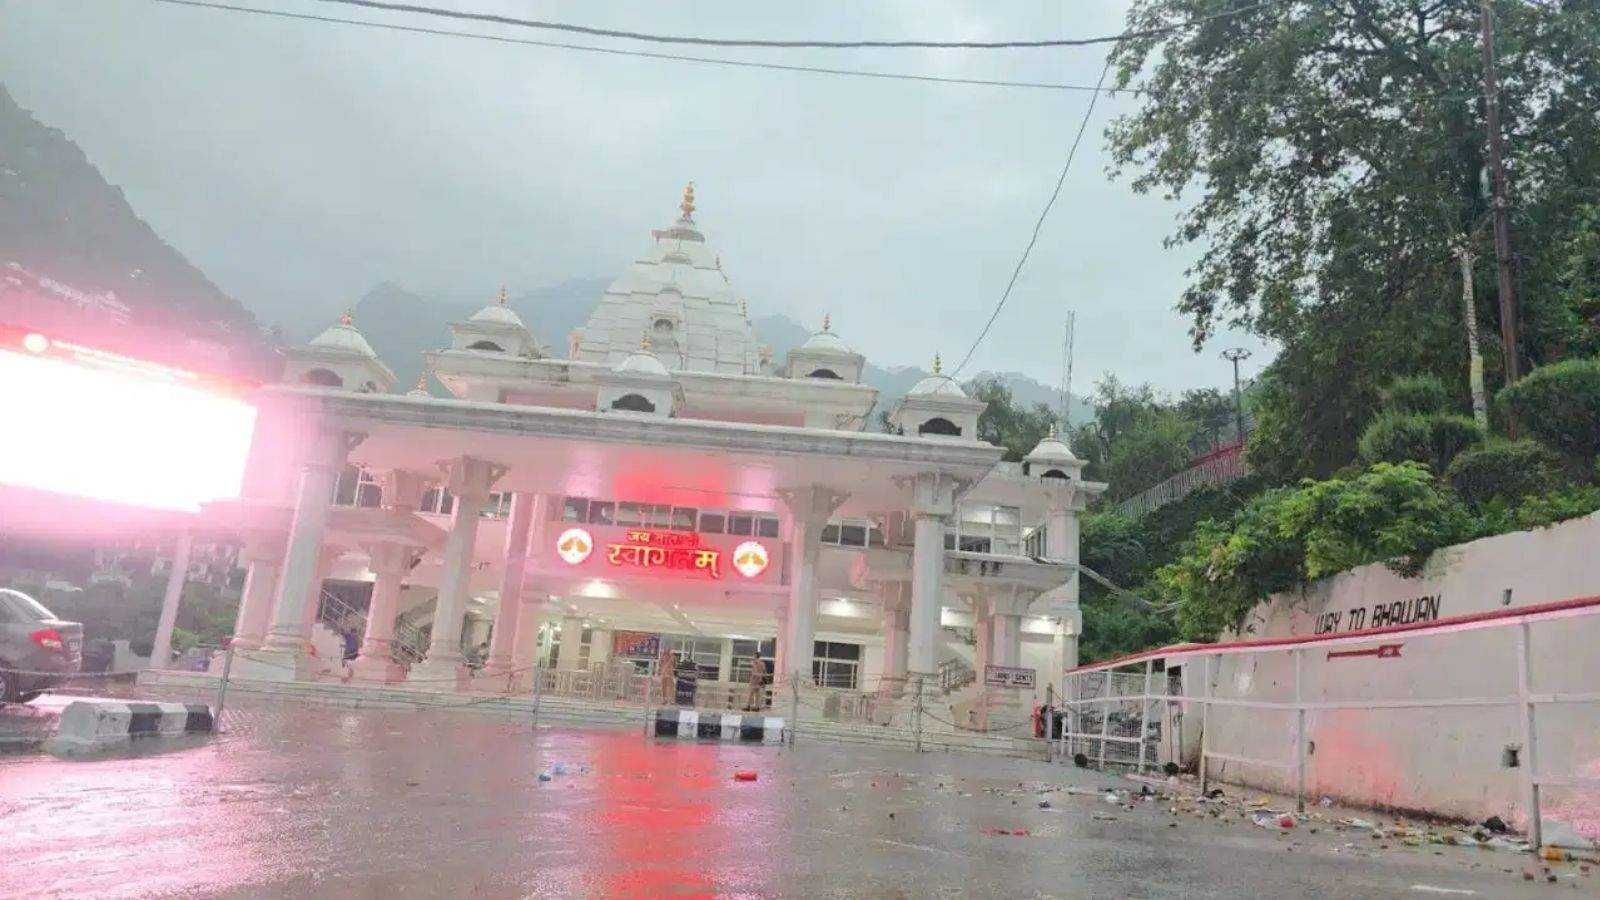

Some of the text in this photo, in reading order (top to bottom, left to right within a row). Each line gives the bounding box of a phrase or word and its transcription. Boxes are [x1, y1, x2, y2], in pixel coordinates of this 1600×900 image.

[627, 530, 650, 543] जय
[1314, 594, 1441, 635] WAY TO BHAWAN
